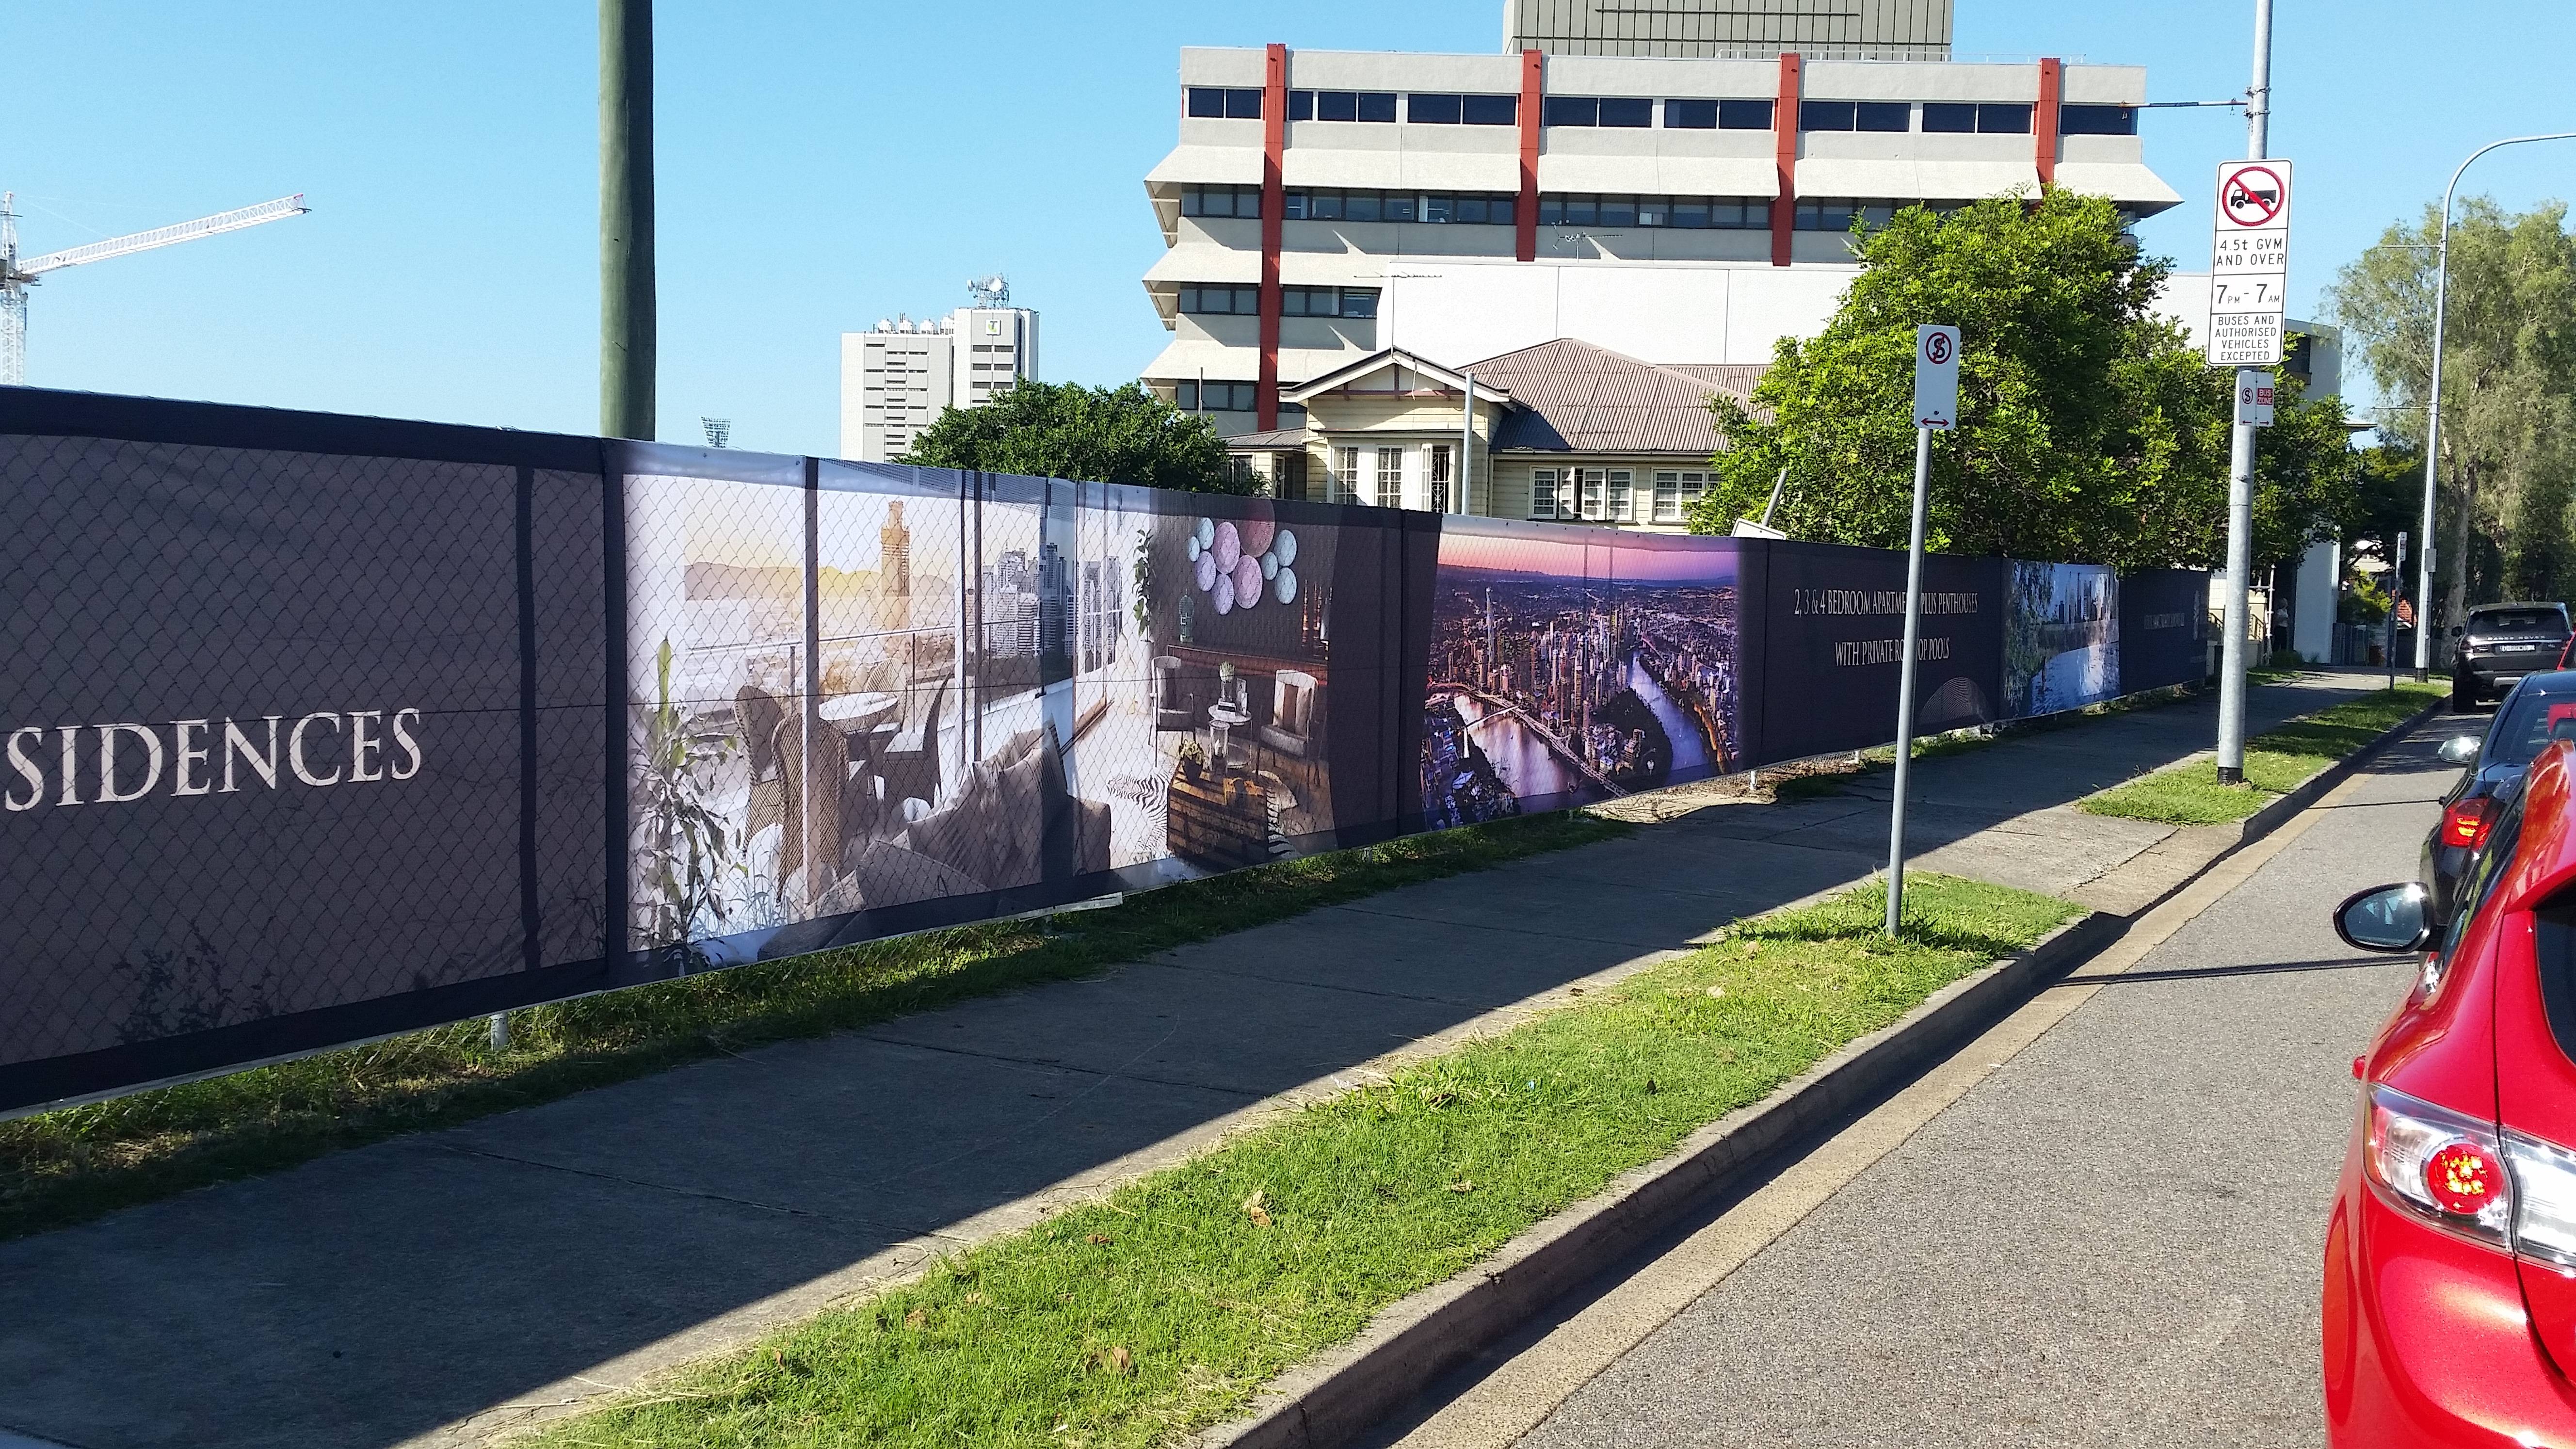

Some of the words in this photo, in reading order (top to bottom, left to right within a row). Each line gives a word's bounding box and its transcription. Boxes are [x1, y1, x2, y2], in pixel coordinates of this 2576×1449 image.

[2220, 239, 2248, 251] 4.5t
[2256, 238, 2282, 250] GVM
[2216, 255, 2242, 266] AND
[2250, 253, 2284, 265] OVER
[2218, 316, 2249, 325] BUSES
[2254, 315, 2274, 324] AND
[2215, 327, 2276, 338] AUTHORISED
[2222, 339, 2269, 349] VEHICLES
[2221, 351, 2270, 361] EXCEPTED
[1794, 588, 1802, 618] 2,
[1803, 589, 1810, 615] 3
[1811, 589, 1819, 614] &
[1820, 589, 1826, 614] 4
[1827, 589, 1871, 615] BEDROOM
[1872, 590, 1908, 614] APARTME
[1920, 592, 1937, 614] PLUS
[1938, 593, 1978, 614] PENTHOUSES
[1835, 641, 1860, 666] WITH
[1861, 639, 1893, 665] PRIVATE
[1895, 638, 1928, 661] ROOP
[1928, 637, 1950, 660] POOLS
[5, 708, 422, 812] SIDENCES
